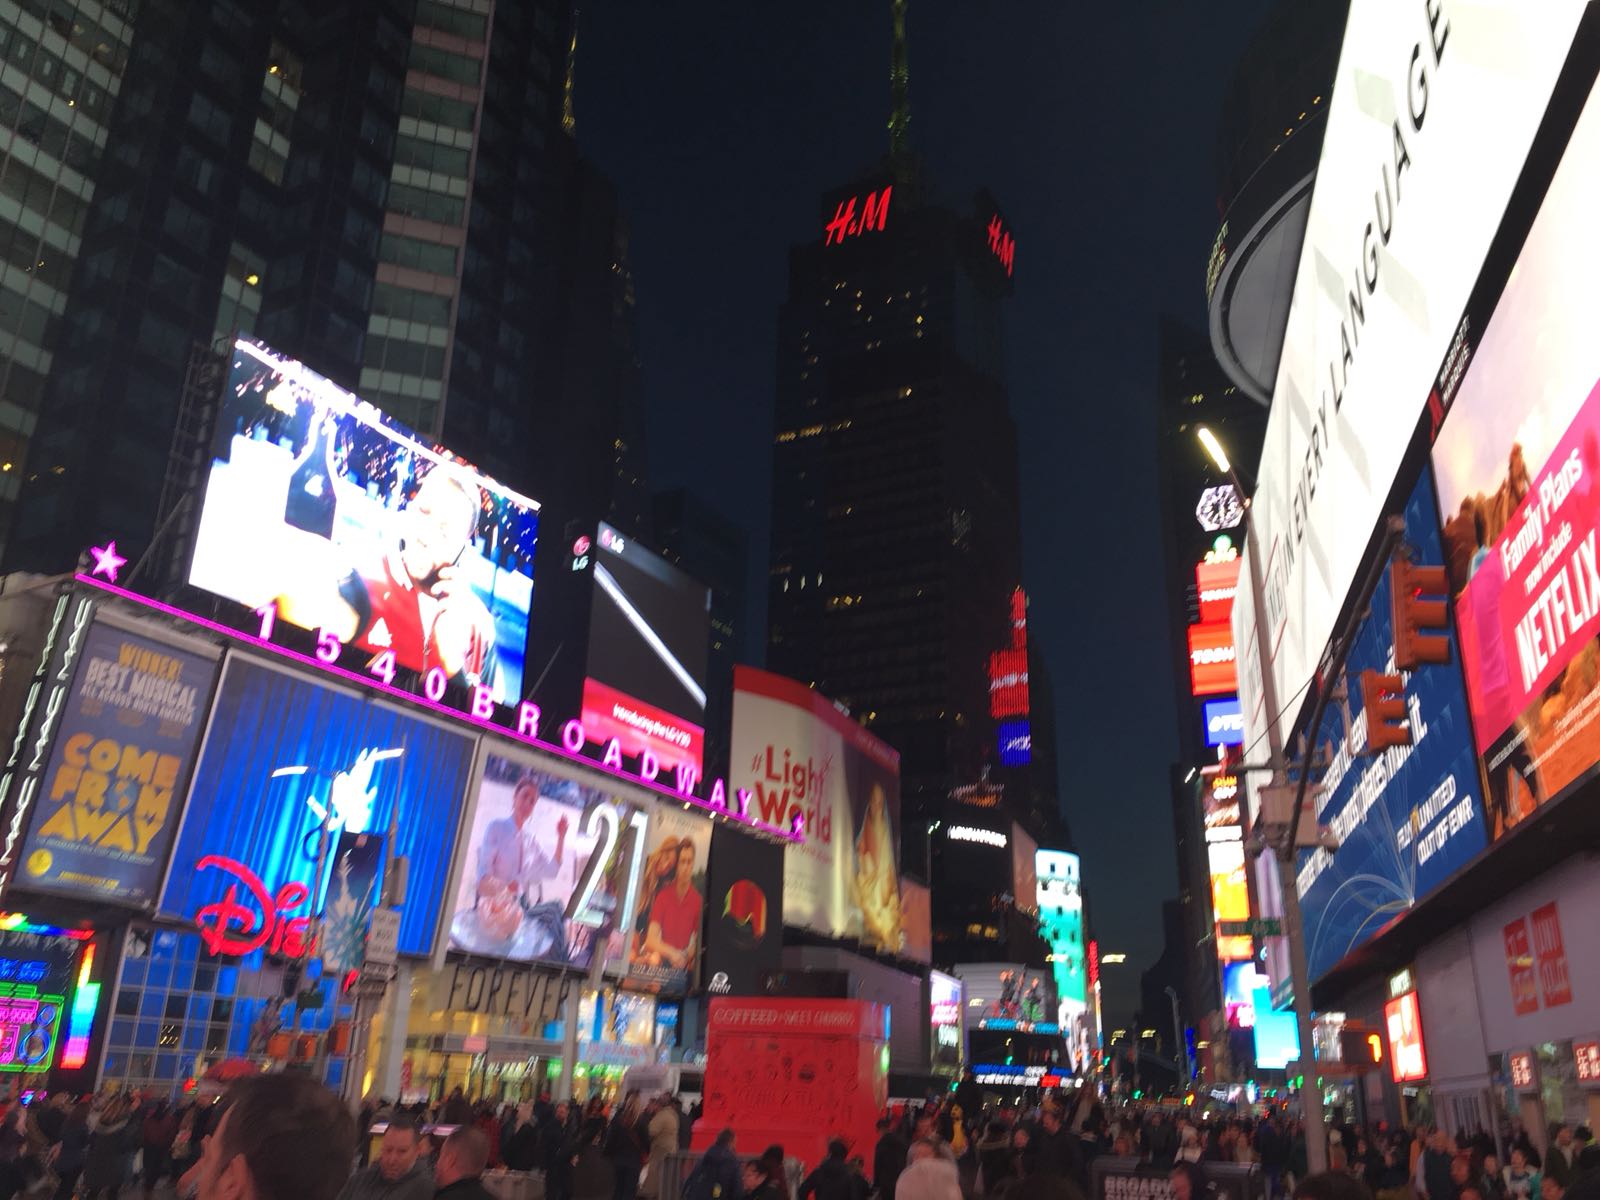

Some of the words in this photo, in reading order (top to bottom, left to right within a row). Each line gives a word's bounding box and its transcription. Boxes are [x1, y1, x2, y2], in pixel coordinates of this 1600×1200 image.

[826, 185, 892, 247] H&M
[988, 213, 1015, 278] H&M
[1293, 394, 1330, 546] EVERY
[1330, 0, 1451, 414] LANGUAGE
[611, 534, 625, 554] LG
[1501, 503, 1543, 582] Family
[1530, 447, 1584, 524] Plans
[572, 555, 589, 571] LG
[1524, 567, 1543, 596] now
[1540, 520, 1574, 581] include
[1515, 527, 1600, 694] NETFLIX
[84, 655, 132, 694] BEST
[127, 669, 198, 714] MUSICAL
[255, 601, 448, 703] 1540
[470, 682, 753, 819] BROADWAY
[63, 732, 182, 790] COME
[37, 802, 163, 856] AWAY
[561, 802, 649, 935] 21
[446, 962, 571, 1023] FOREVER
